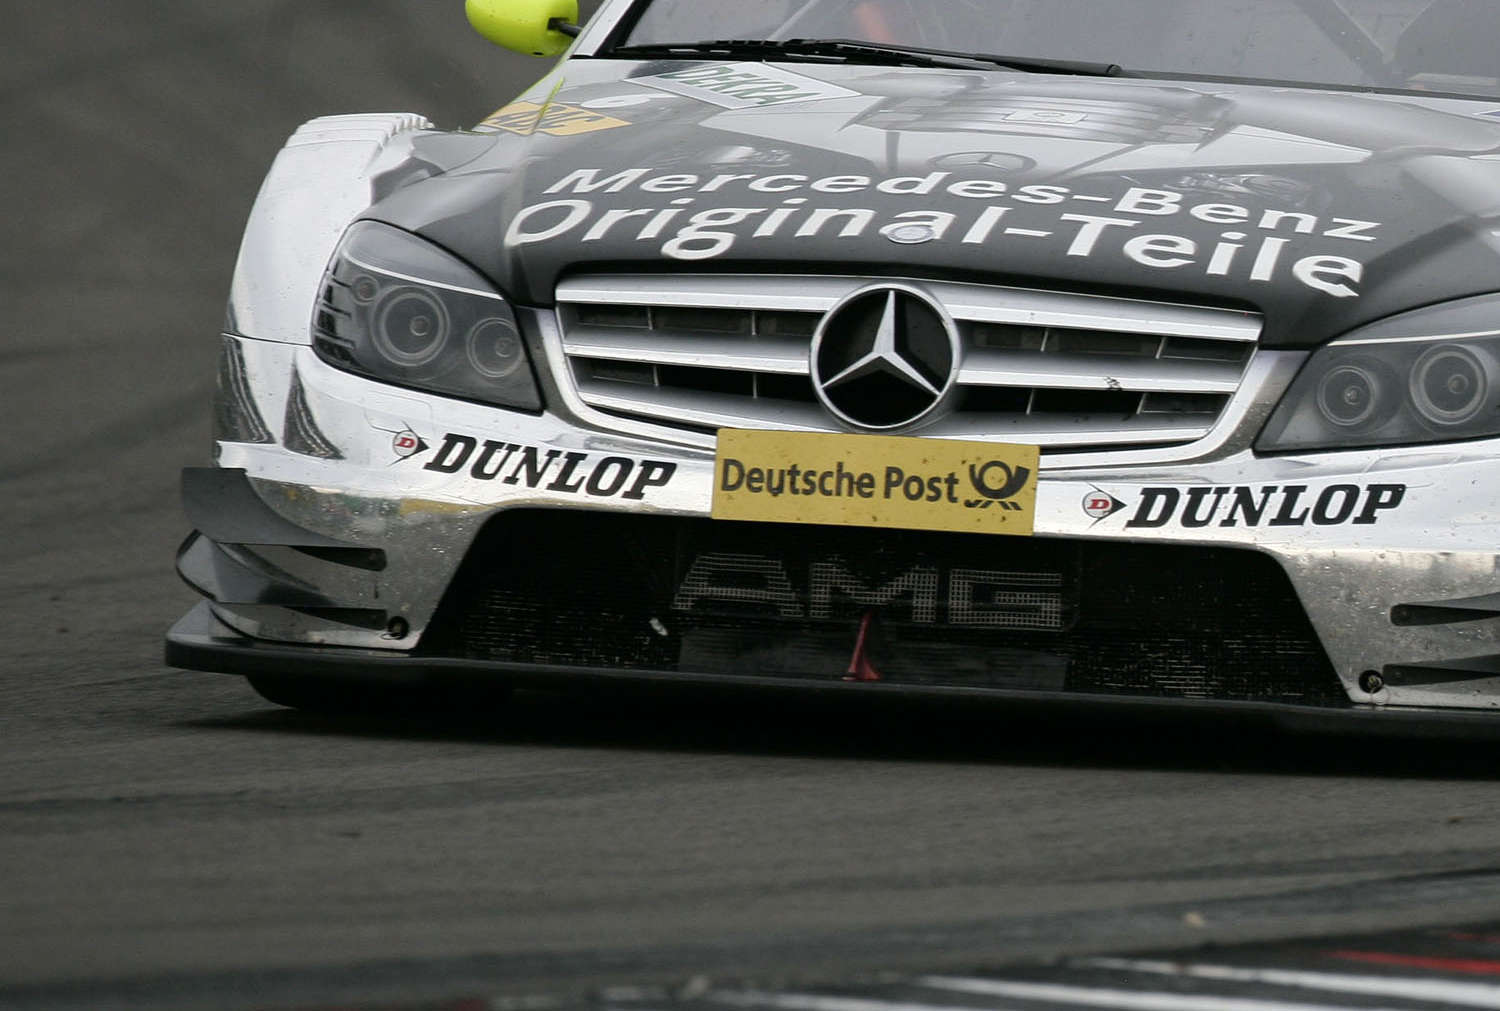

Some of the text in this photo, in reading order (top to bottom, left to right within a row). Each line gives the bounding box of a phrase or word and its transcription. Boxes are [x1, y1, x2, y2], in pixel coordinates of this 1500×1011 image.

[656, 66, 823, 104] DEKRA
[543, 168, 1381, 241] Mercedes-Benz
[505, 198, 1364, 297] Original-Teile
[423, 433, 677, 500] DUNLOP
[722, 458, 960, 503] Deutsche Post
[1125, 483, 1406, 528] DUNLOP
[669, 552, 1063, 630] AMG
